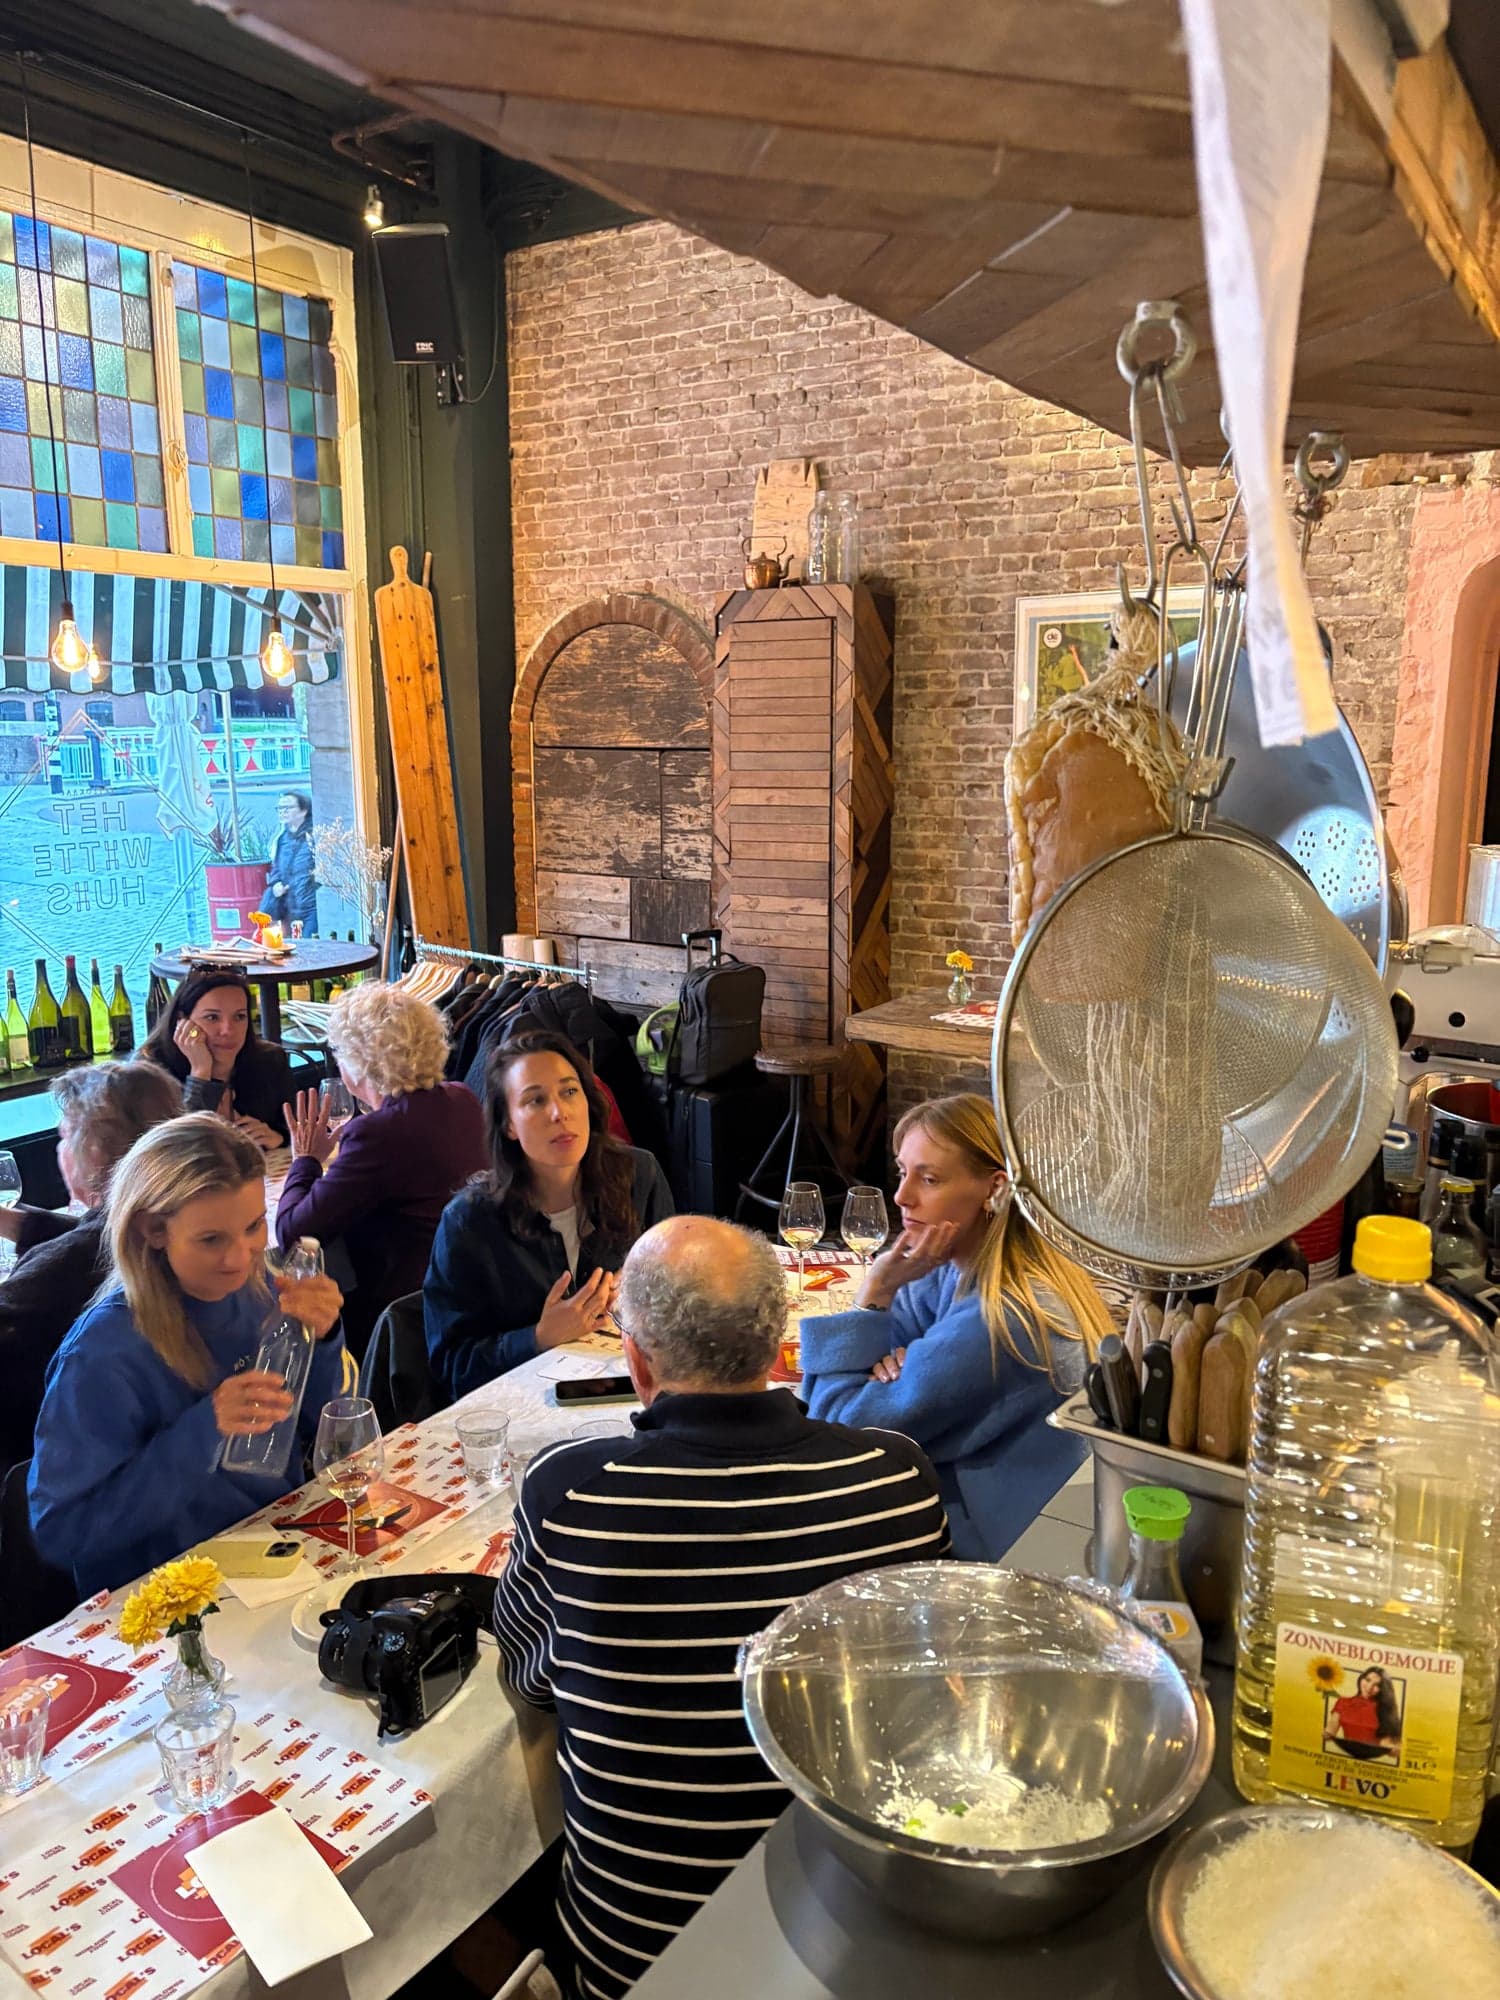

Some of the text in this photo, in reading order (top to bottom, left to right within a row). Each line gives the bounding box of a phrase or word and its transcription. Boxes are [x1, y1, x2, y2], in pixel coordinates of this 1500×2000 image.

[1284, 1629, 1456, 1675] ZONNEBLOEMOLIE
[274, 1731, 320, 1766] LOCAL'S
[336, 1768, 382, 1801] LOCAL'S
[1324, 1771, 1390, 1799] LEVO
[84, 1803, 137, 1835] LOCAL'S
[326, 1802, 374, 1839] LOCAL'S
[72, 1838, 126, 1871] LOCAL'S
[50, 1878, 107, 1912] LOCAL'S
[21, 1923, 82, 1960] LOCAL'S
